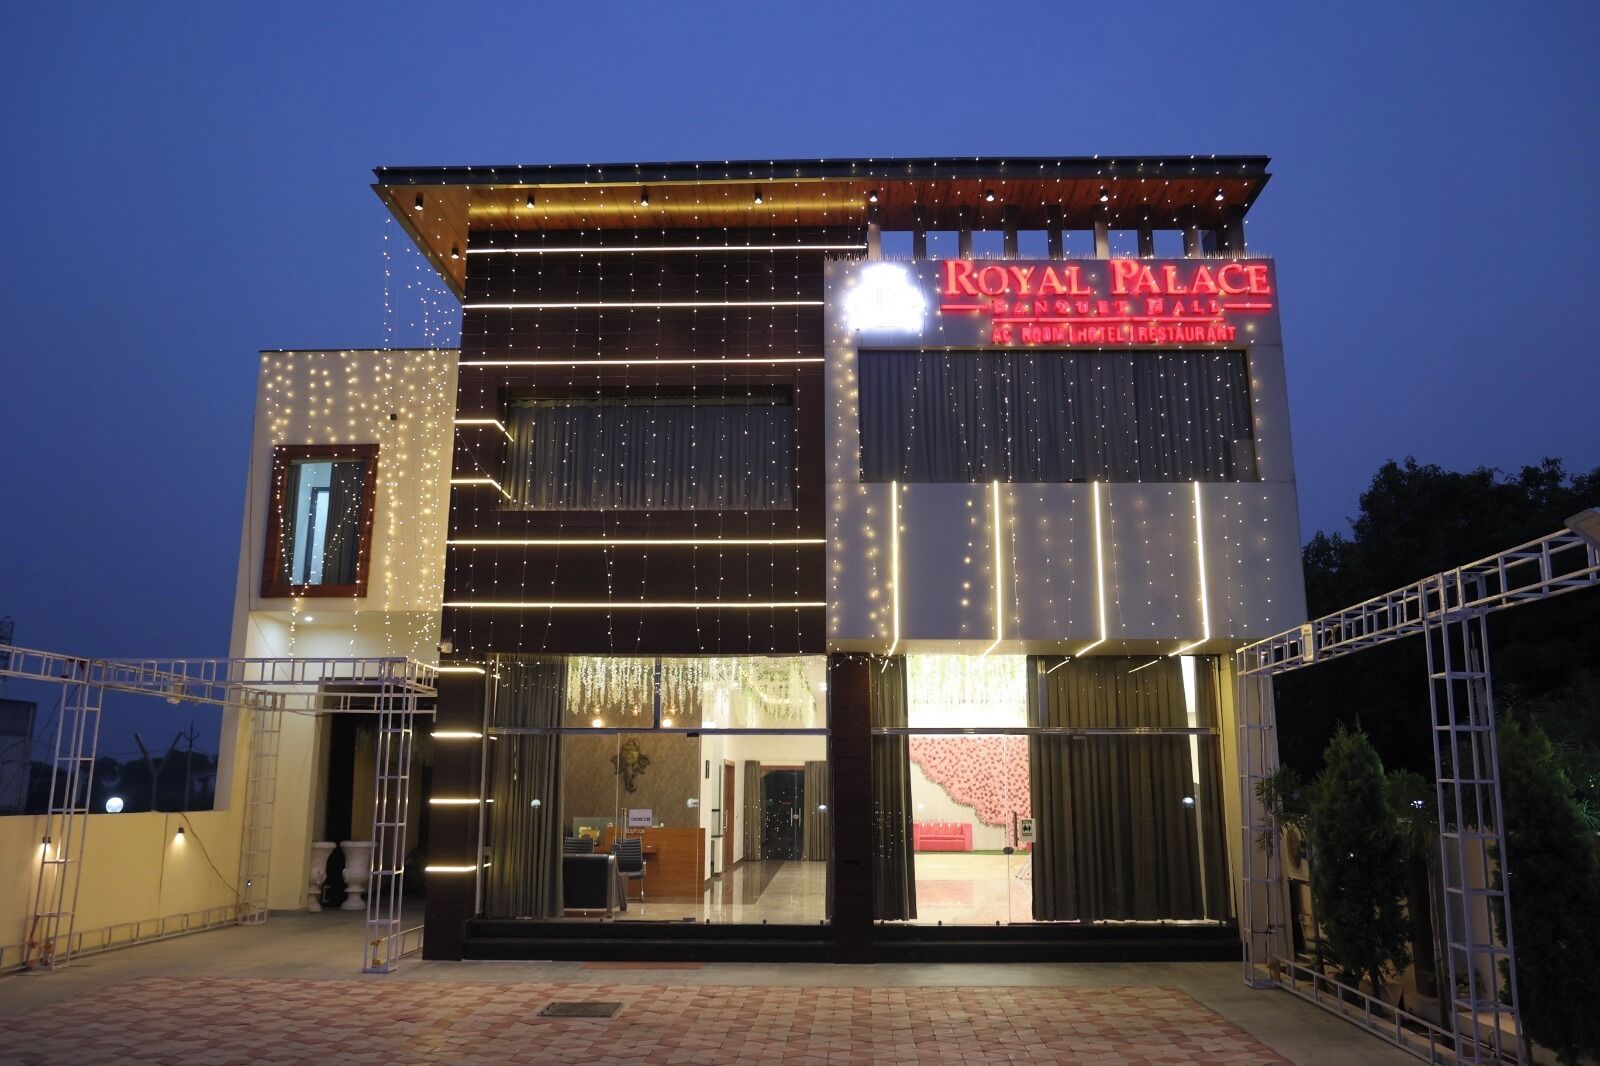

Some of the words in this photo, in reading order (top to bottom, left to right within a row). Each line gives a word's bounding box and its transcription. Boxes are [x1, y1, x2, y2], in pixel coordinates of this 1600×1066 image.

[944, 259, 1091, 296] ROYAL
[1110, 259, 1271, 296] PALACE
[993, 299, 1128, 314] BANQUET
[1146, 298, 1220, 315] HALL
[992, 327, 1012, 343] AC
[1022, 326, 1065, 343] ROOM
[1078, 326, 1124, 343] HOTEL
[1137, 326, 1236, 342] RESTAURANT
